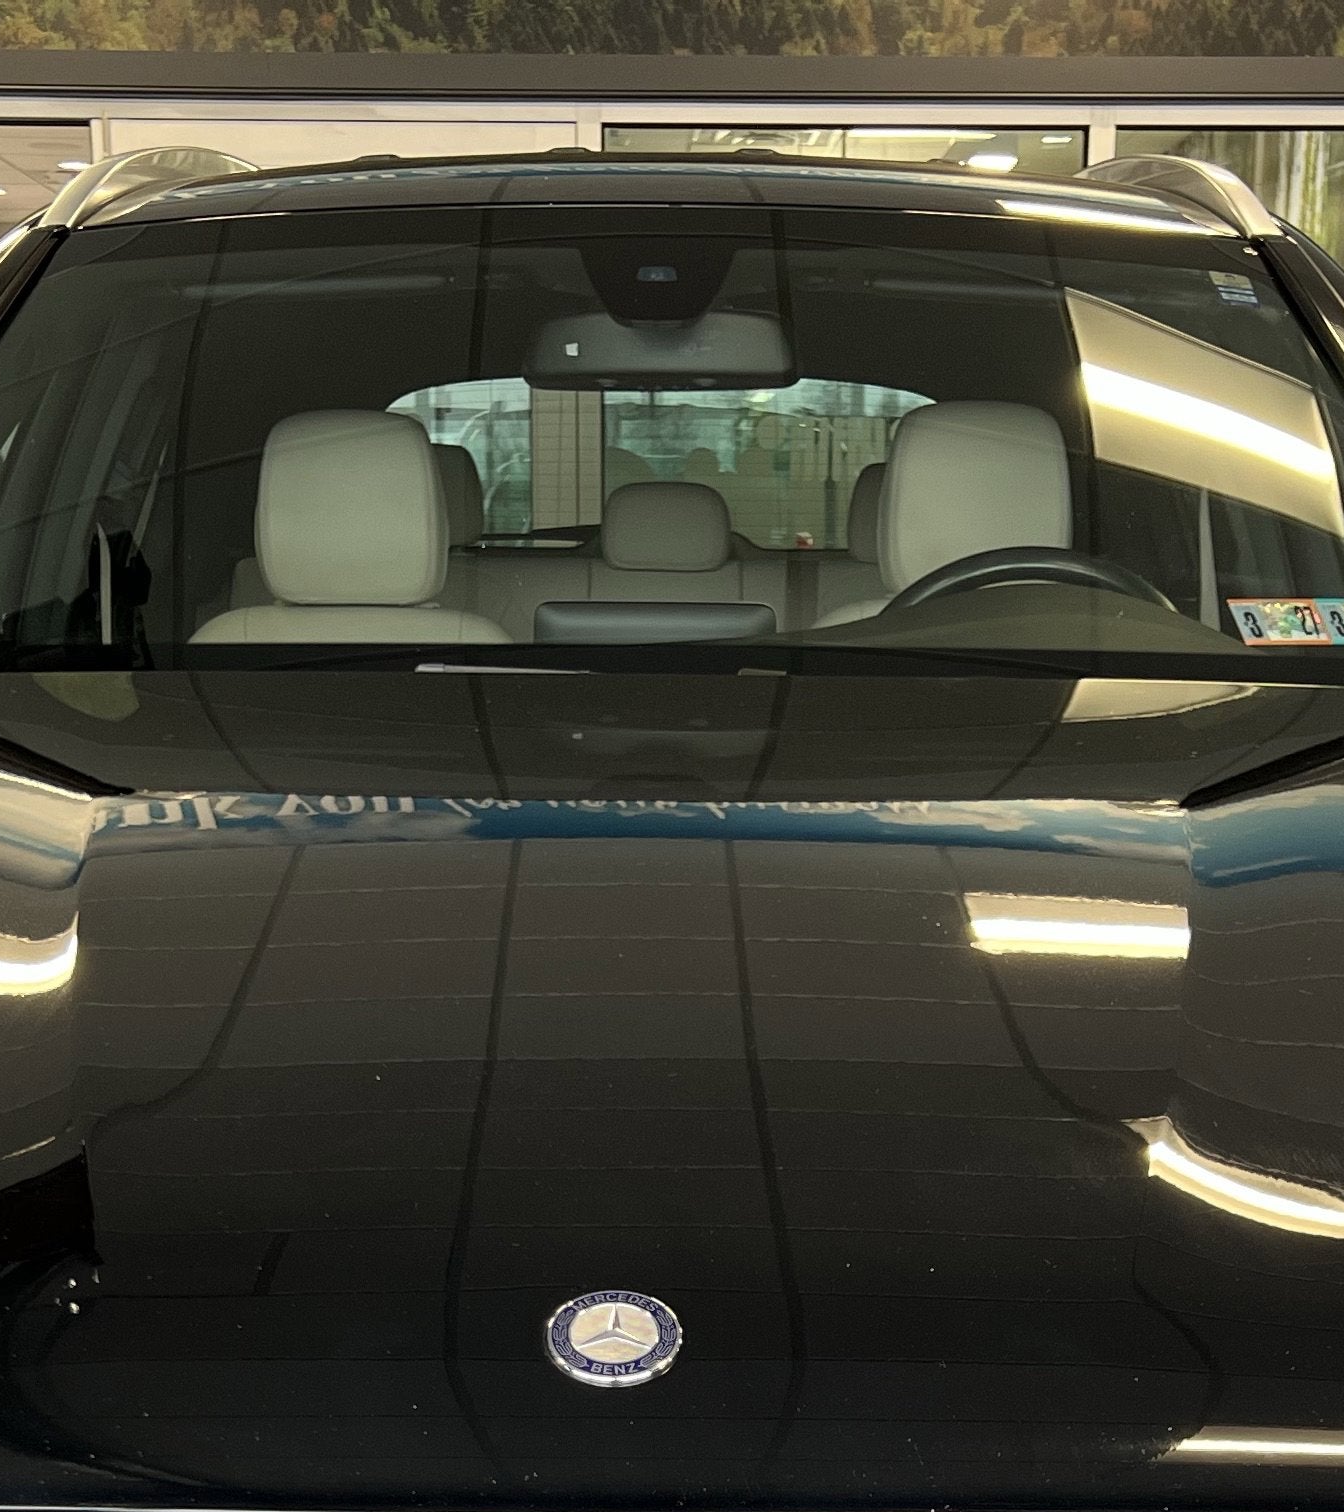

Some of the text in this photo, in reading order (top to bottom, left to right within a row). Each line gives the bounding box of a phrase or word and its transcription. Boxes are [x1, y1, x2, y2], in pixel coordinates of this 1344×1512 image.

[1243, 611, 1263, 638] 3
[571, 1292, 659, 1313] MERCEDES
[590, 1361, 641, 1376] BENZ
